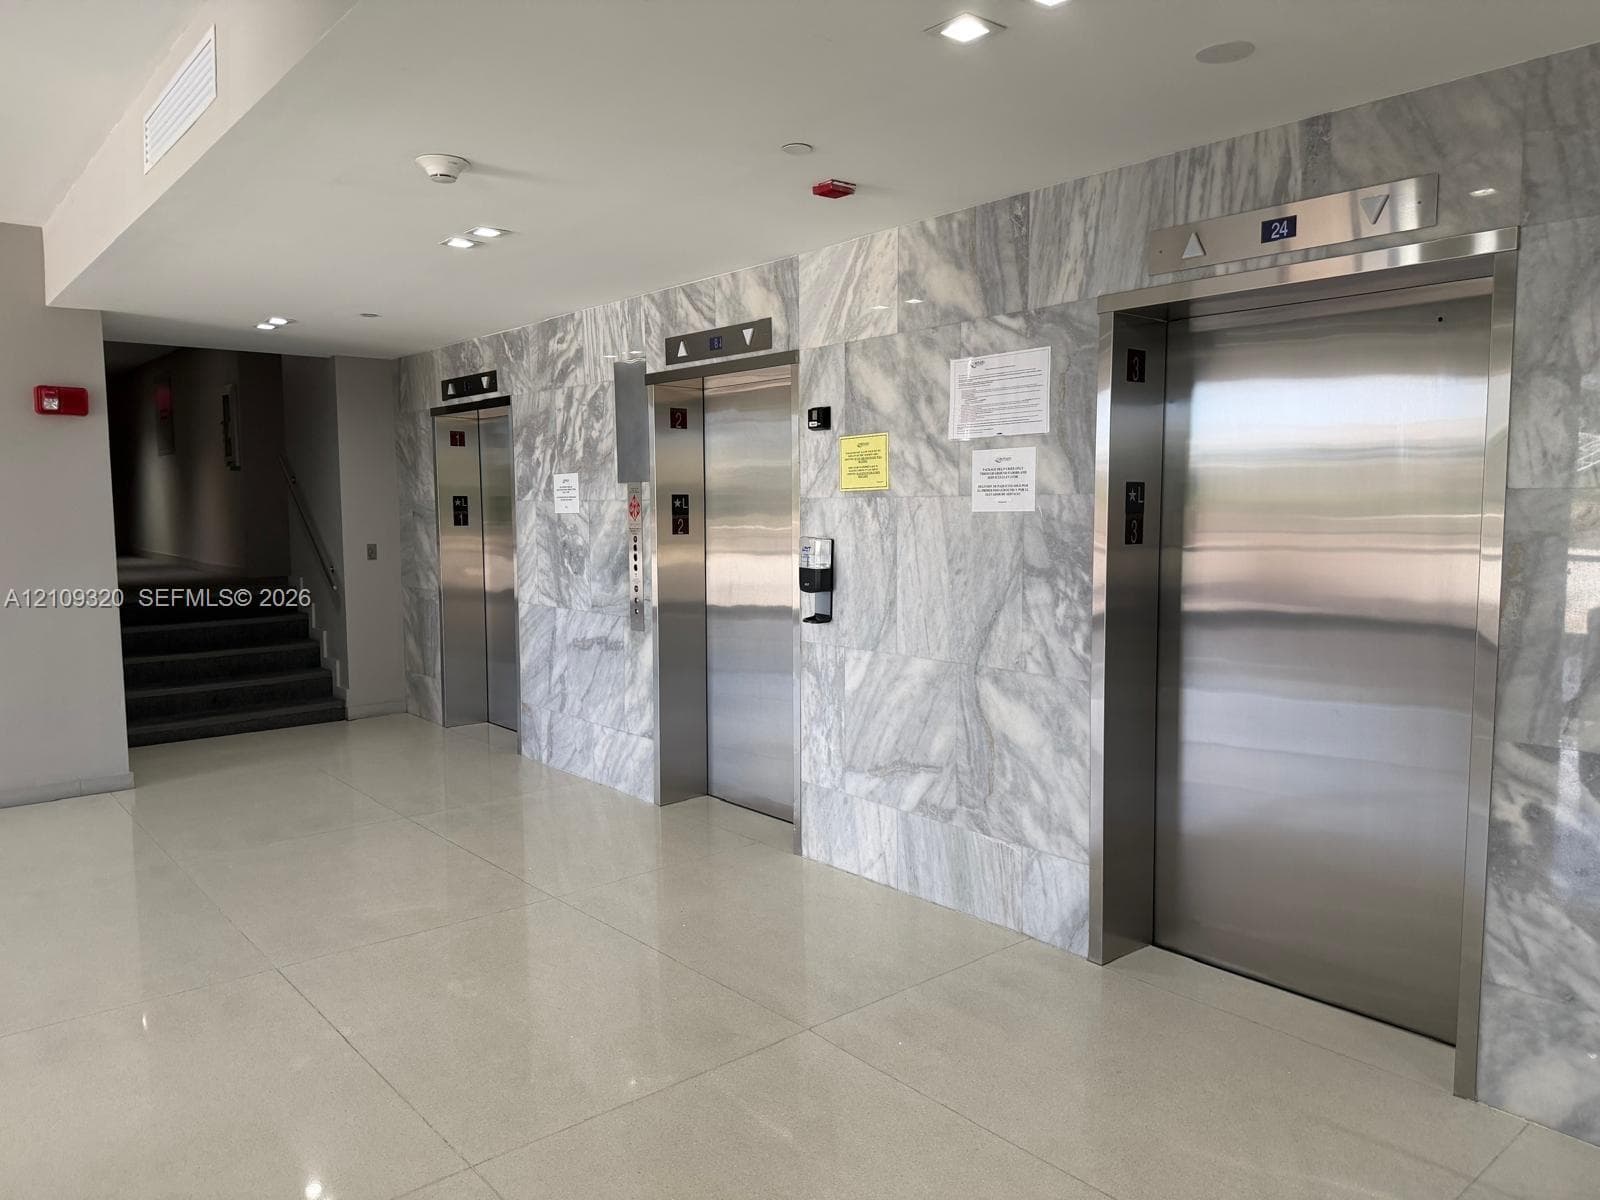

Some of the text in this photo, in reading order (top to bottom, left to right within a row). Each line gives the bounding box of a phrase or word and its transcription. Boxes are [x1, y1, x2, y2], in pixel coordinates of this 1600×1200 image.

[1271, 220, 1289, 239] 24
[1132, 355, 1140, 381] 3
[675, 412, 682, 429] 2
[677, 518, 684, 534] 2
[1131, 519, 1138, 544] 3
